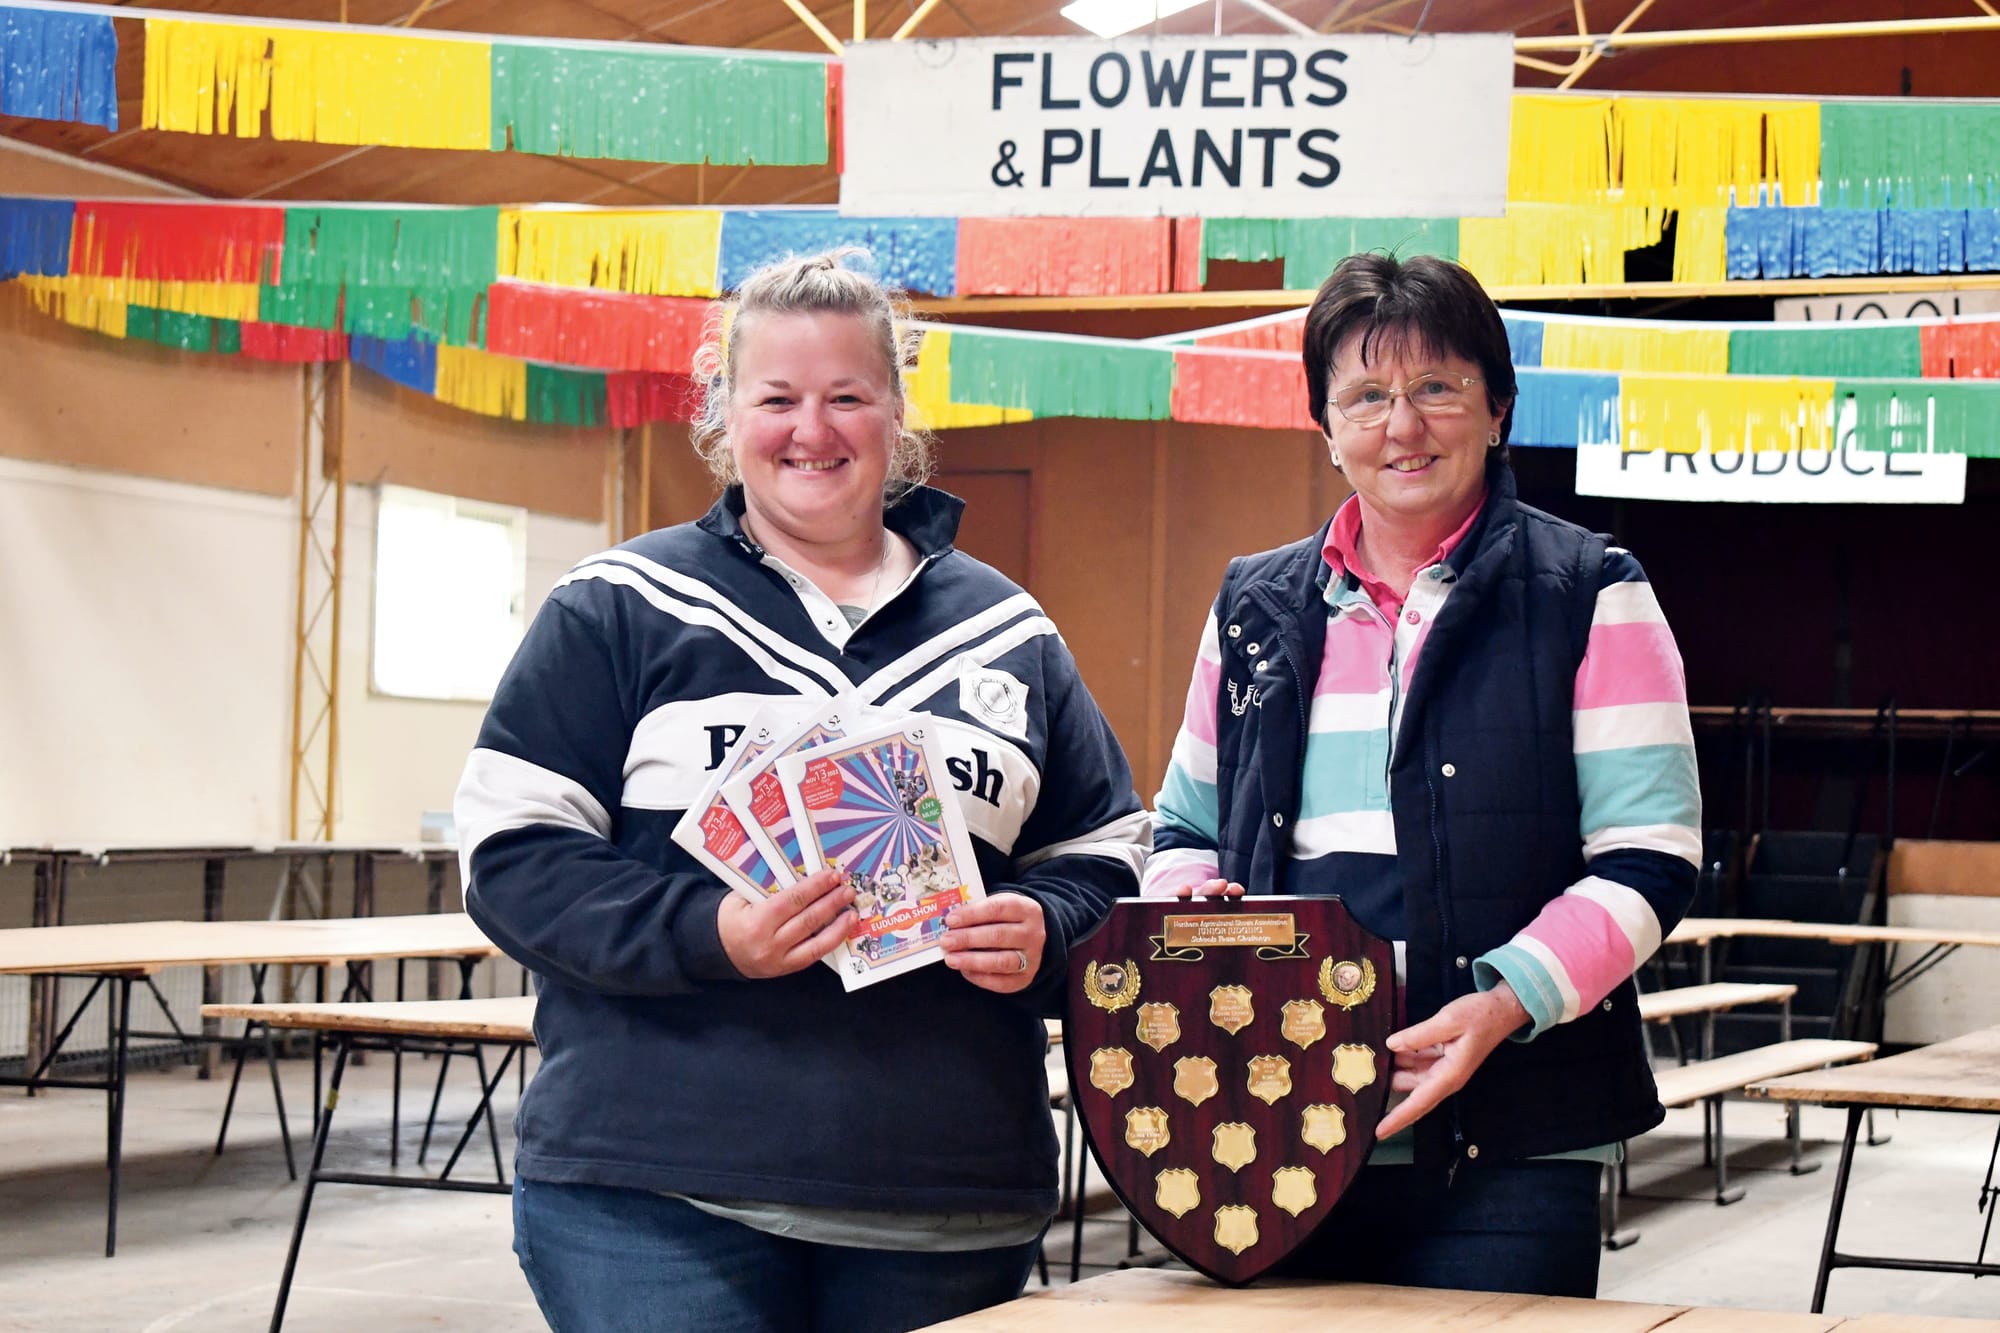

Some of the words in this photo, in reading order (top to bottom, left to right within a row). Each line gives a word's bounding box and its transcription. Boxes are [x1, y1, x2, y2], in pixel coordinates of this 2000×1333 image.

[992, 49, 1349, 110] FLOWERS
[991, 139, 1025, 188] &
[1041, 128, 1342, 188] PLANTS
[870, 912, 912, 932] EUDUNDA
[911, 902, 938, 918] SHOW
